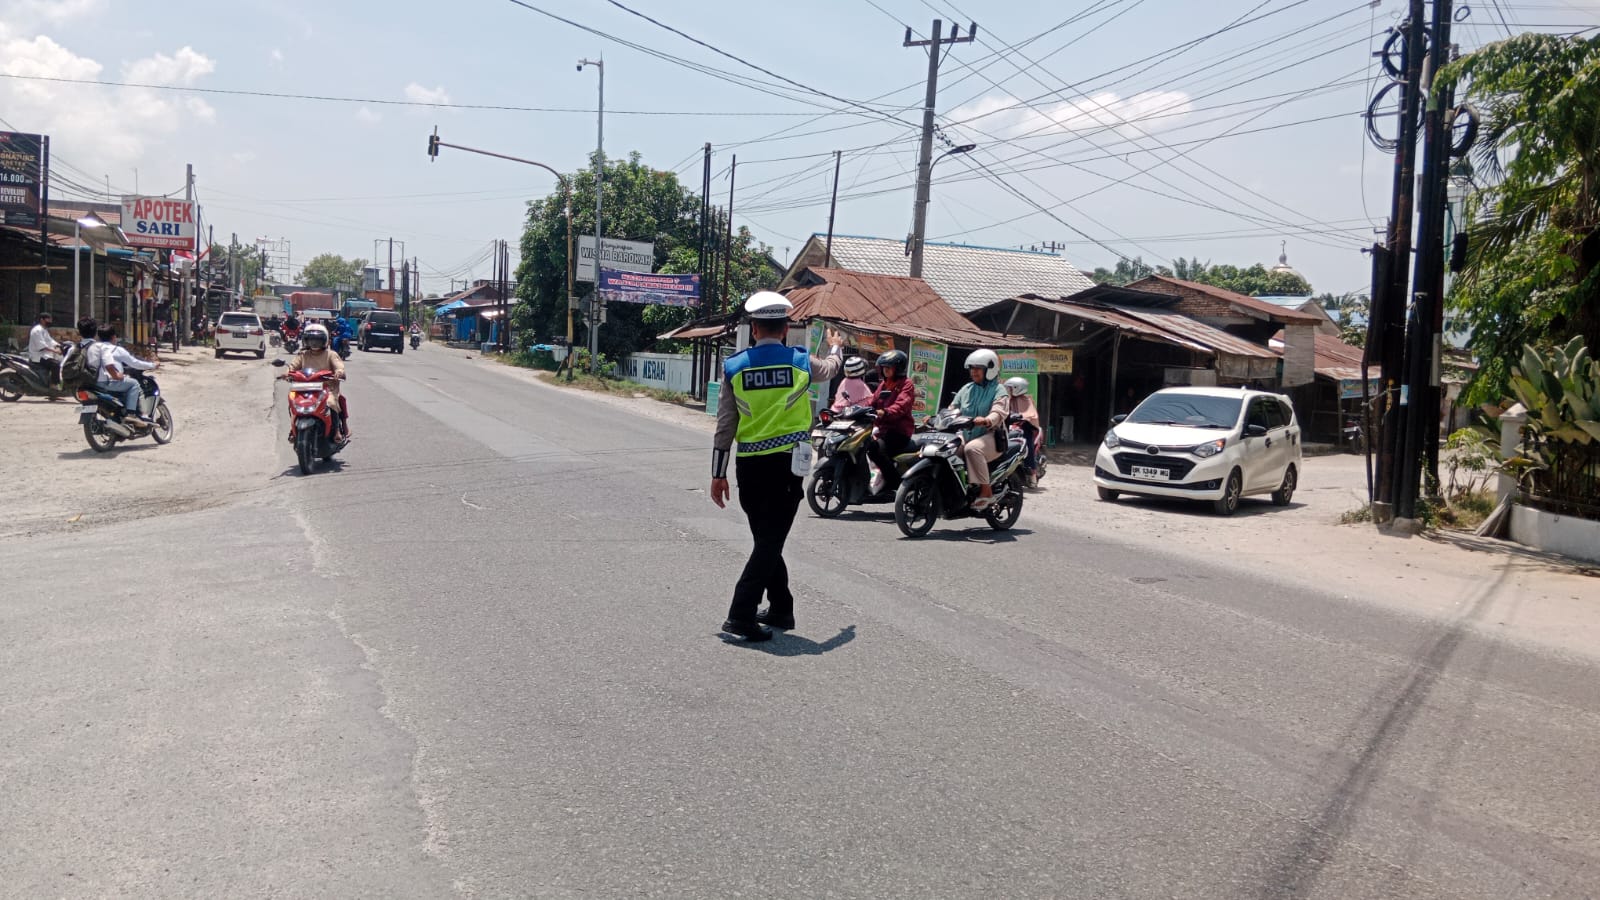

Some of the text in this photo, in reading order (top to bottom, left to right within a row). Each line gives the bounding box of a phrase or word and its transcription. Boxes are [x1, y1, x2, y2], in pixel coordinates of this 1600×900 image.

[133, 198, 193, 223] APOTEK
[136, 220, 180, 236] SARI
[612, 250, 652, 265] BAROKAH
[643, 359, 666, 381] MERAH
[744, 369, 791, 388] POLISI
